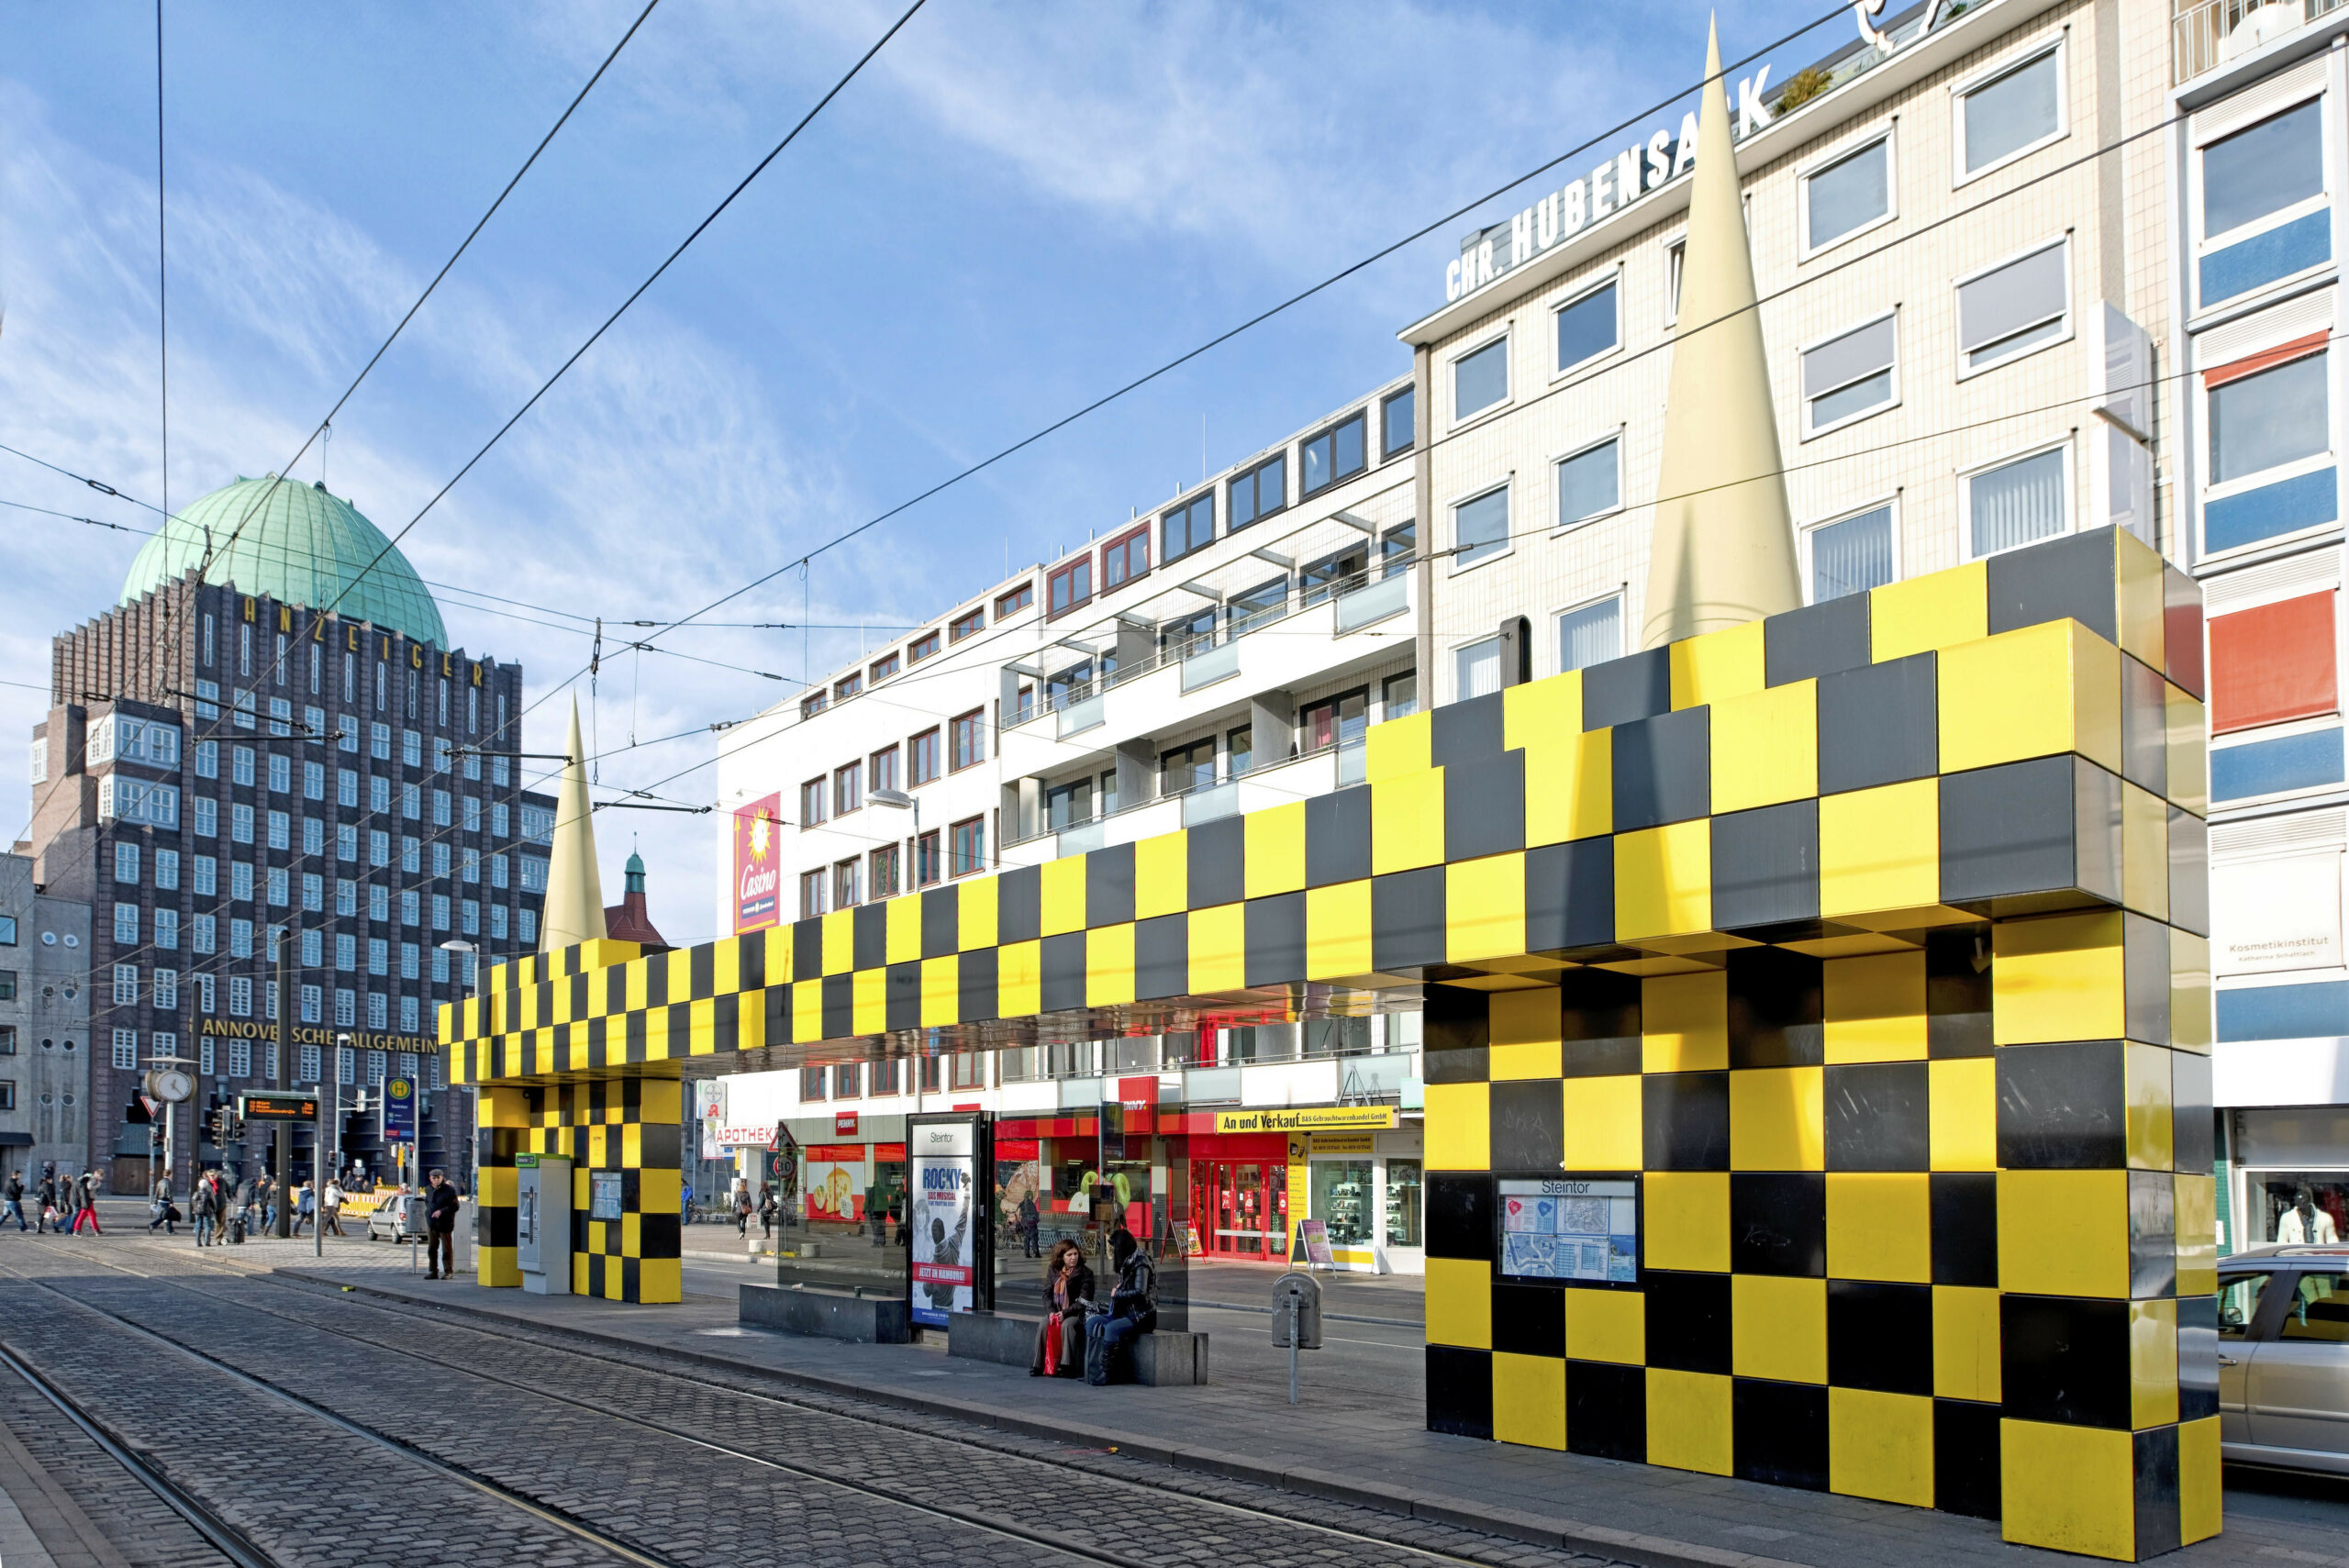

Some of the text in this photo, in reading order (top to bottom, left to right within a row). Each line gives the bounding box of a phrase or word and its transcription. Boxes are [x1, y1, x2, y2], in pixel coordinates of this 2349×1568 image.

[1446, 63, 1772, 302] CHR. HUBENSAK
[244, 596, 483, 686] ANZEIGER
[740, 864, 776, 900] Casino
[2229, 937, 2329, 952] Kosmetikinstitut
[1224, 1113, 1299, 1129] An und Verkauf
[1313, 1113, 1370, 1121] Gebrauchtwarenhandel
[930, 1132, 953, 1143] Steintor
[923, 1168, 962, 1189] ROCKY
[1542, 1179, 1590, 1194] Steintor
